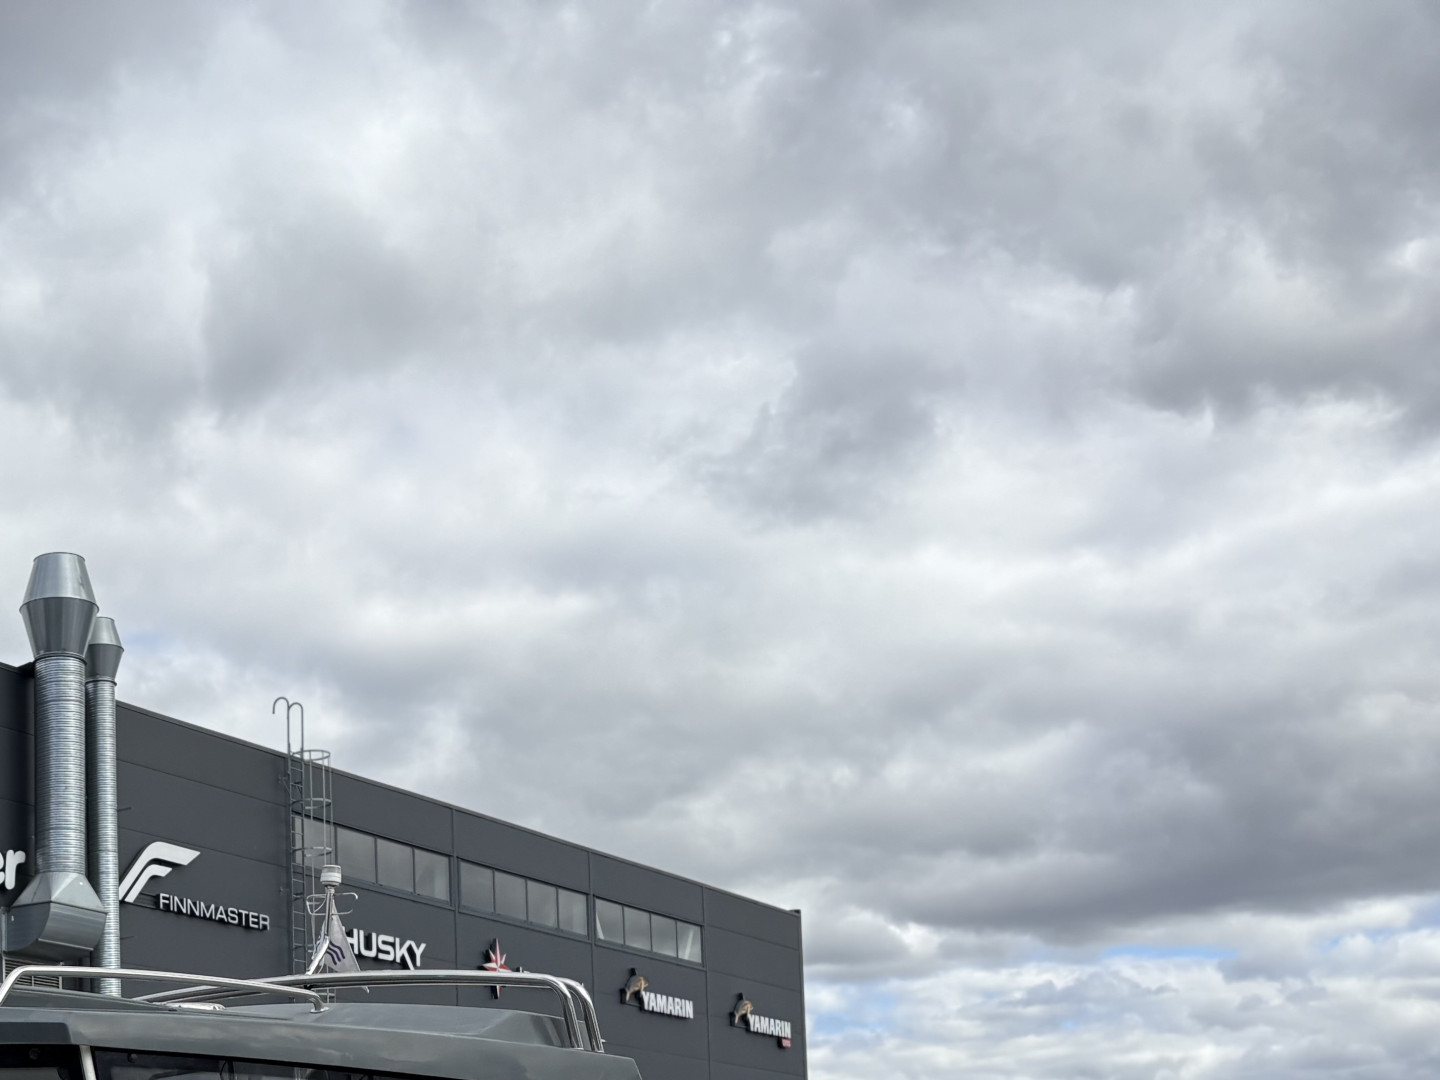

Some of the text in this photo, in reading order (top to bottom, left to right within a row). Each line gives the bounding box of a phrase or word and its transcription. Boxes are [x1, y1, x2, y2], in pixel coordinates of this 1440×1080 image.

[160, 893, 270, 931] FINNMASTER
[342, 926, 427, 970] HUSKY
[642, 991, 693, 1019] YAMARIN
[749, 1014, 791, 1038] YAMARIN
